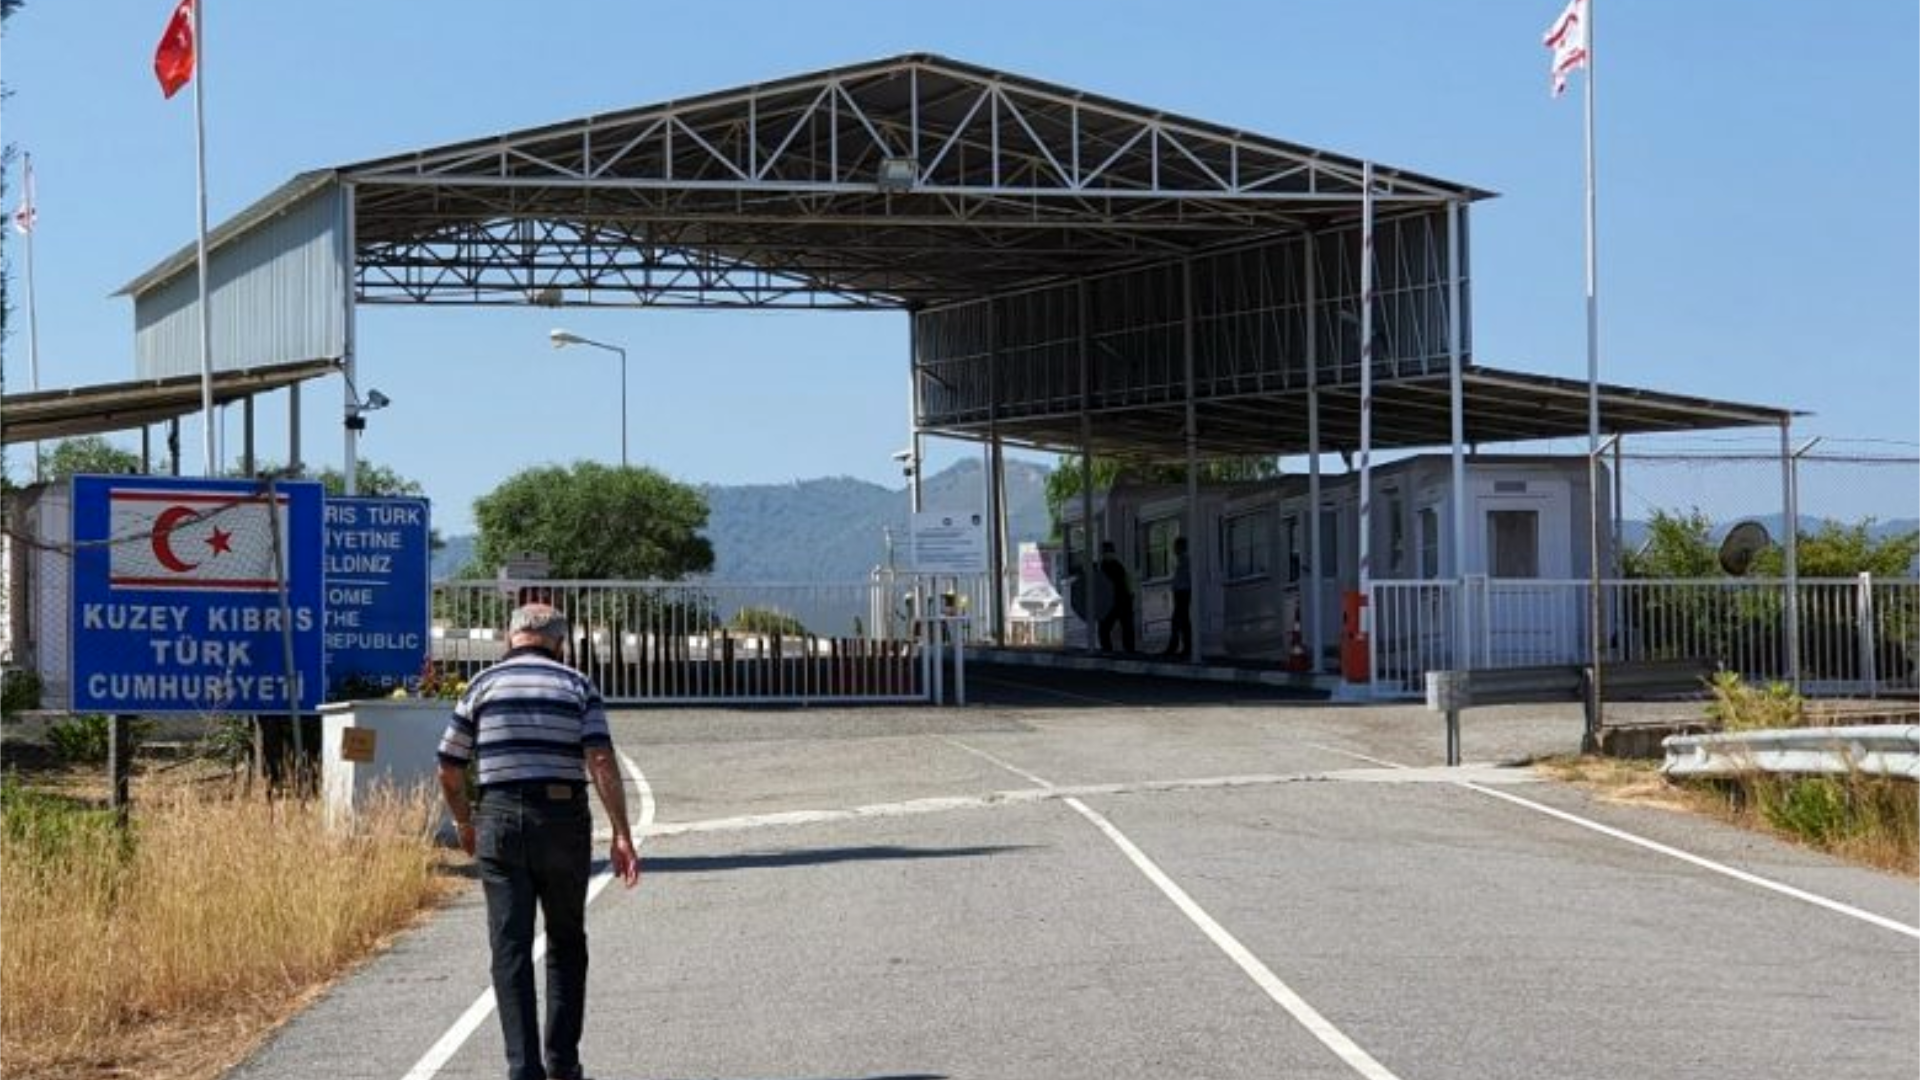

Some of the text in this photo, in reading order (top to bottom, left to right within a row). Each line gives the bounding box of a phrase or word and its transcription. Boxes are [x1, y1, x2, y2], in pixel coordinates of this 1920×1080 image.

[366, 501, 420, 526] TÜRK
[325, 588, 373, 605] OME
[83, 603, 313, 632] KUZEY KIBRIS
[150, 633, 251, 666] TÜRK
[88, 669, 304, 701] CUMHURİYETİ
